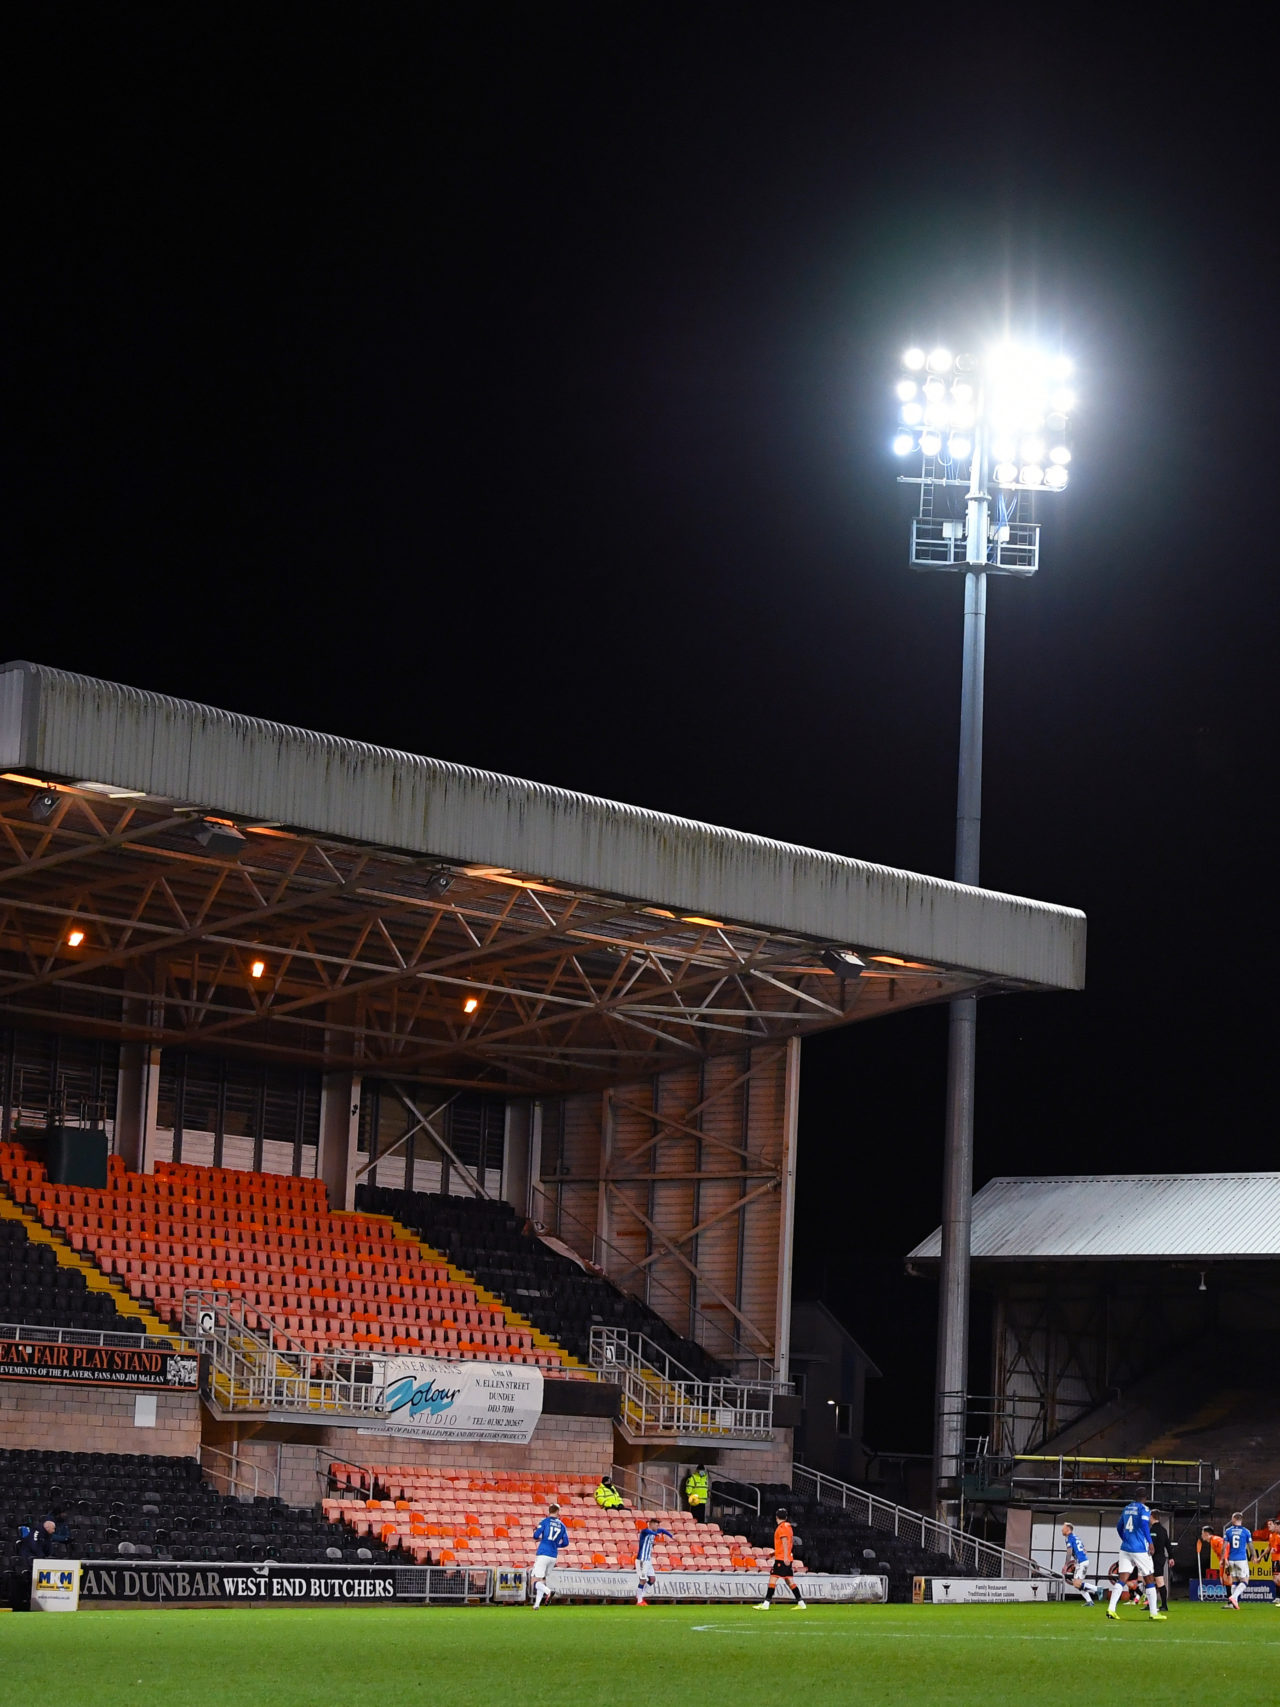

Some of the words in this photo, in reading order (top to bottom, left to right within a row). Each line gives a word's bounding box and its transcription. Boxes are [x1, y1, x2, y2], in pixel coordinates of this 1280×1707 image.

[201, 1313, 213, 1333] C
[34, 1345, 67, 1367] FAIR
[72, 1348, 111, 1369] PLAY
[113, 1351, 162, 1372] STAND
[38, 1368, 48, 1376] OF
[49, 1369, 62, 1377] THE
[63, 1370, 93, 1380] PLAYERS,
[94, 1371, 110, 1380] FANS
[111, 1373, 125, 1381] AND
[126, 1373, 138, 1382] JIM
[139, 1374, 165, 1383] McLEAN
[483, 1379, 505, 1389] ELLEN
[505, 1381, 530, 1391] STREET
[488, 1392, 515, 1401] DUNDEE
[409, 1412, 458, 1426] STUDIO
[472, 1417, 486, 1425] TEL:
[1125, 1515, 1134, 1532] 4
[548, 1526, 561, 1541] 17
[1232, 1535, 1240, 1549] 6
[39, 1571, 72, 1586] MKM
[123, 1571, 222, 1597] DUNBAR
[223, 1577, 269, 1597] WEST
[272, 1578, 307, 1597] END
[310, 1578, 394, 1598] BUTCHERS
[704, 1582, 732, 1596] EAST
[735, 1582, 792, 1596] FUNCON
[799, 1584, 825, 1597] UITE
